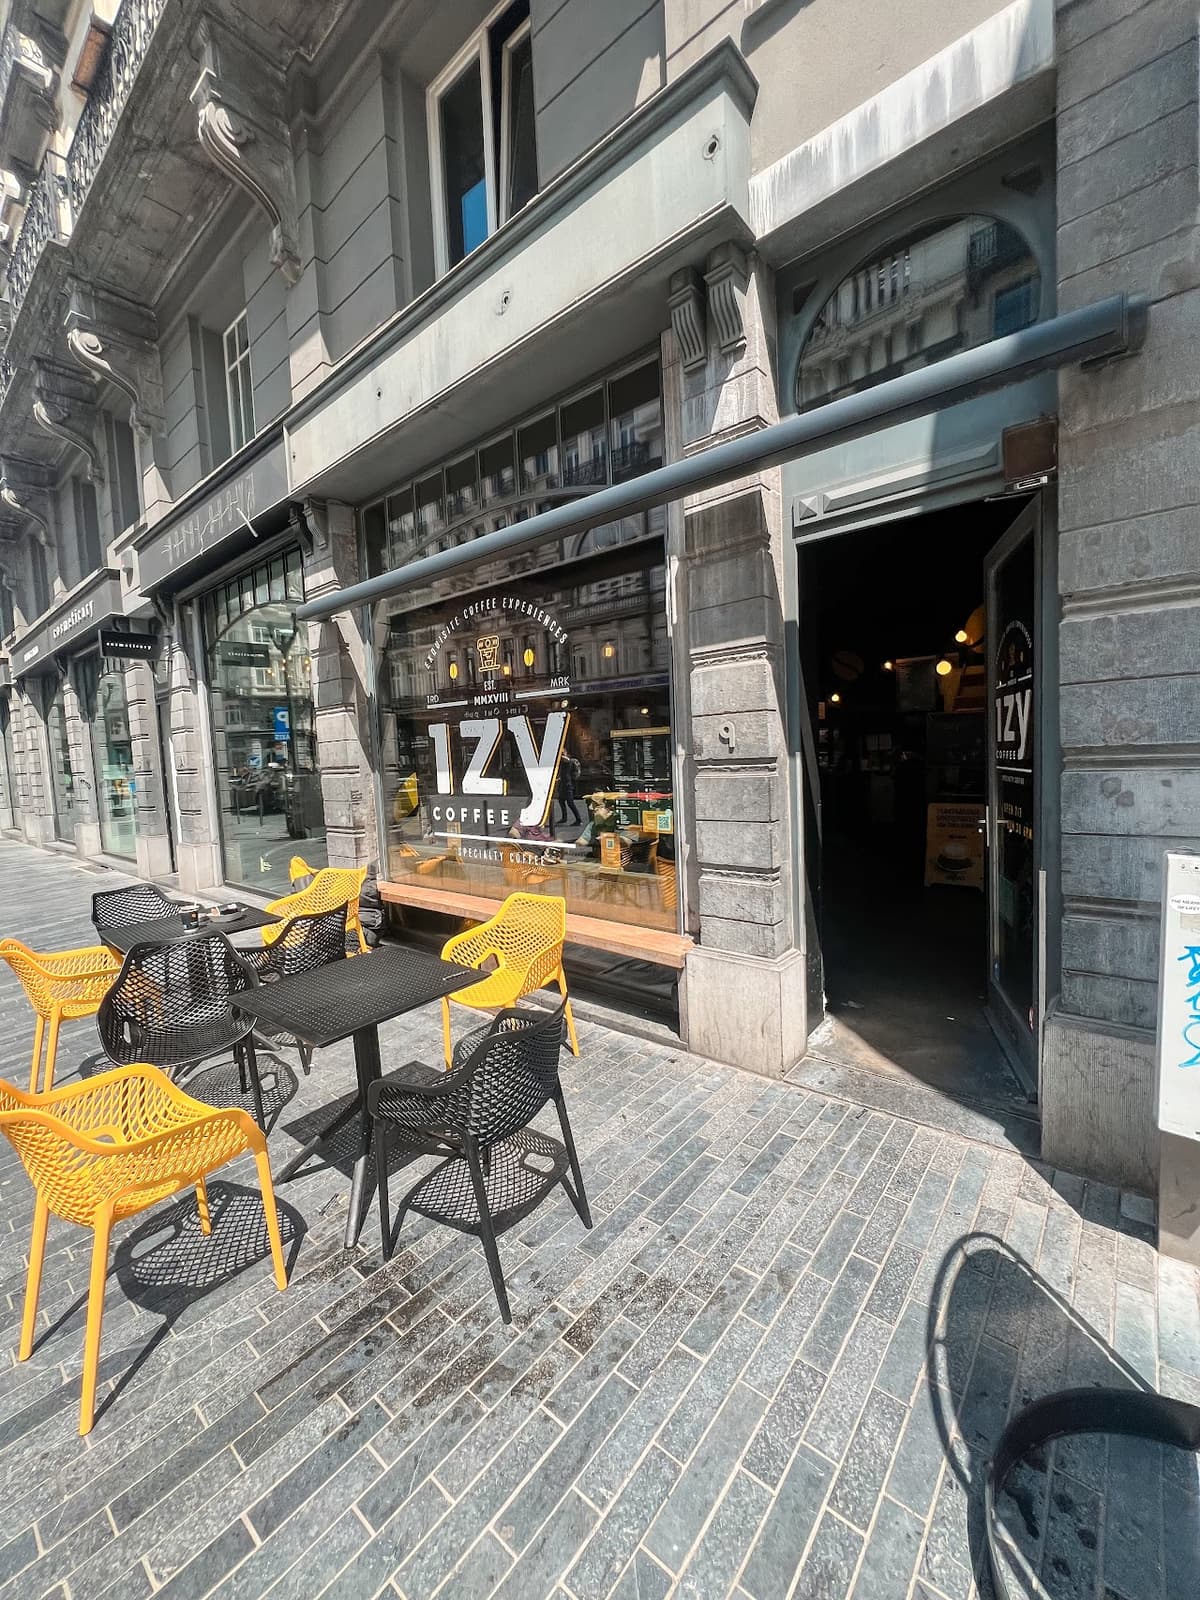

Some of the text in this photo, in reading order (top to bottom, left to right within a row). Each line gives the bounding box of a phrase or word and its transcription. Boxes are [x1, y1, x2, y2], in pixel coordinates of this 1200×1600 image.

[424, 597, 568, 670] EXQUISITE COFFEE EXPERIENCES
[551, 675, 569, 687] MRK
[474, 692, 508, 706] MMXVIII
[995, 750, 1016, 760] COFFEE
[433, 806, 509, 825] COFFEE
[457, 847, 545, 867] SPECIALTY COFFEE
